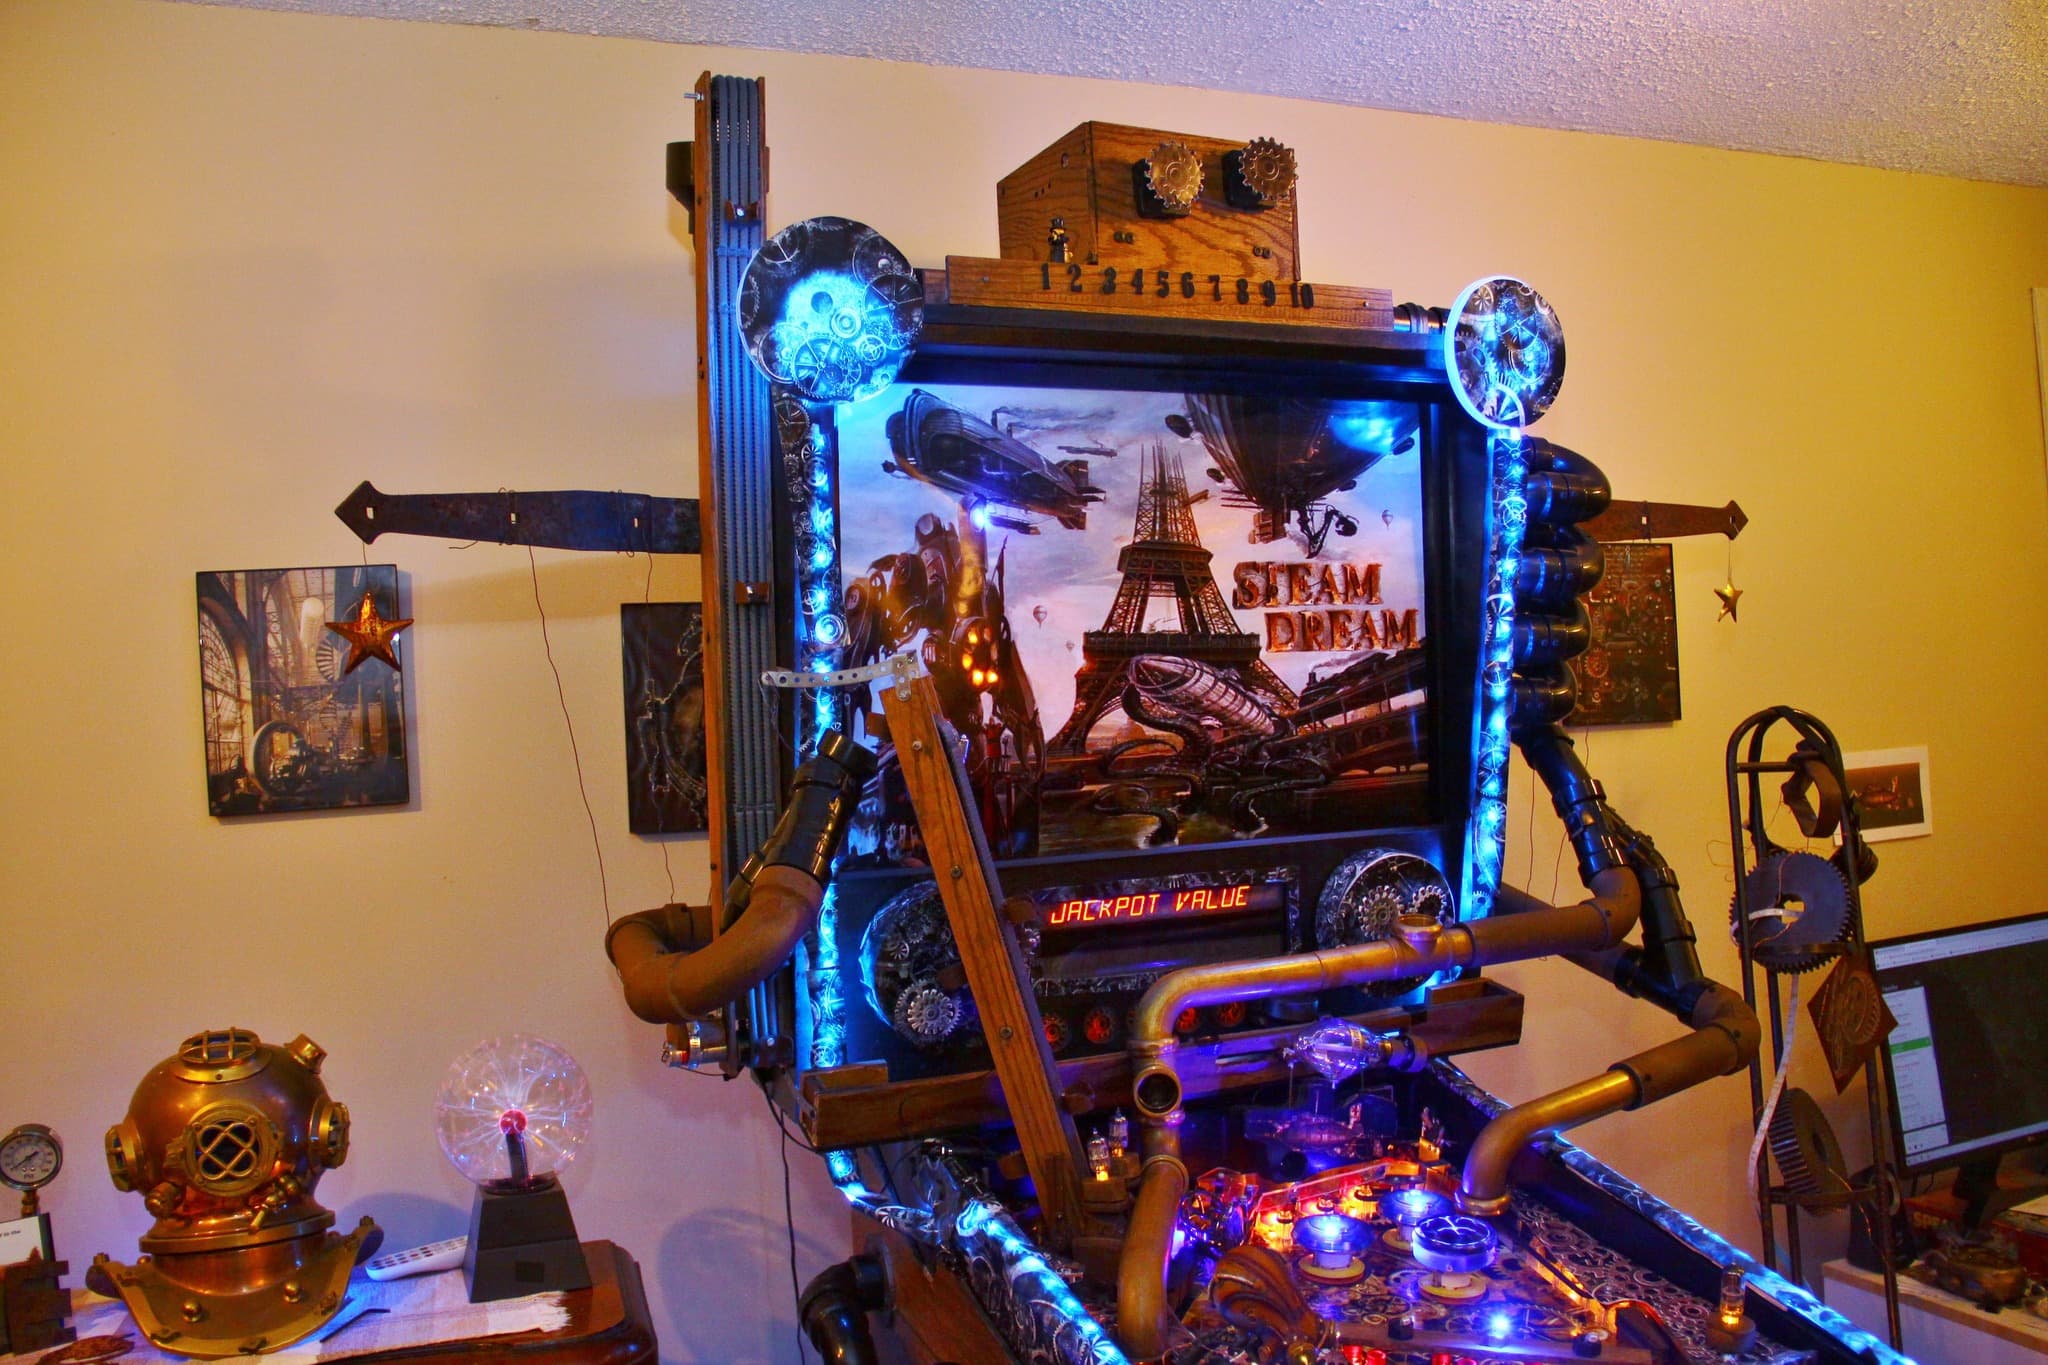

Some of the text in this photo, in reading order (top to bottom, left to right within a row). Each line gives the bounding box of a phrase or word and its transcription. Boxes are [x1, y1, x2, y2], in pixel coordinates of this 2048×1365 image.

[1041, 263, 1314, 309] 1 2 3 4 5 6 7 8 9 10
[1232, 561, 1383, 610] STEAM
[1264, 608, 1419, 652] DREAM
[1050, 885, 1250, 924] JACKPOT VALUE
